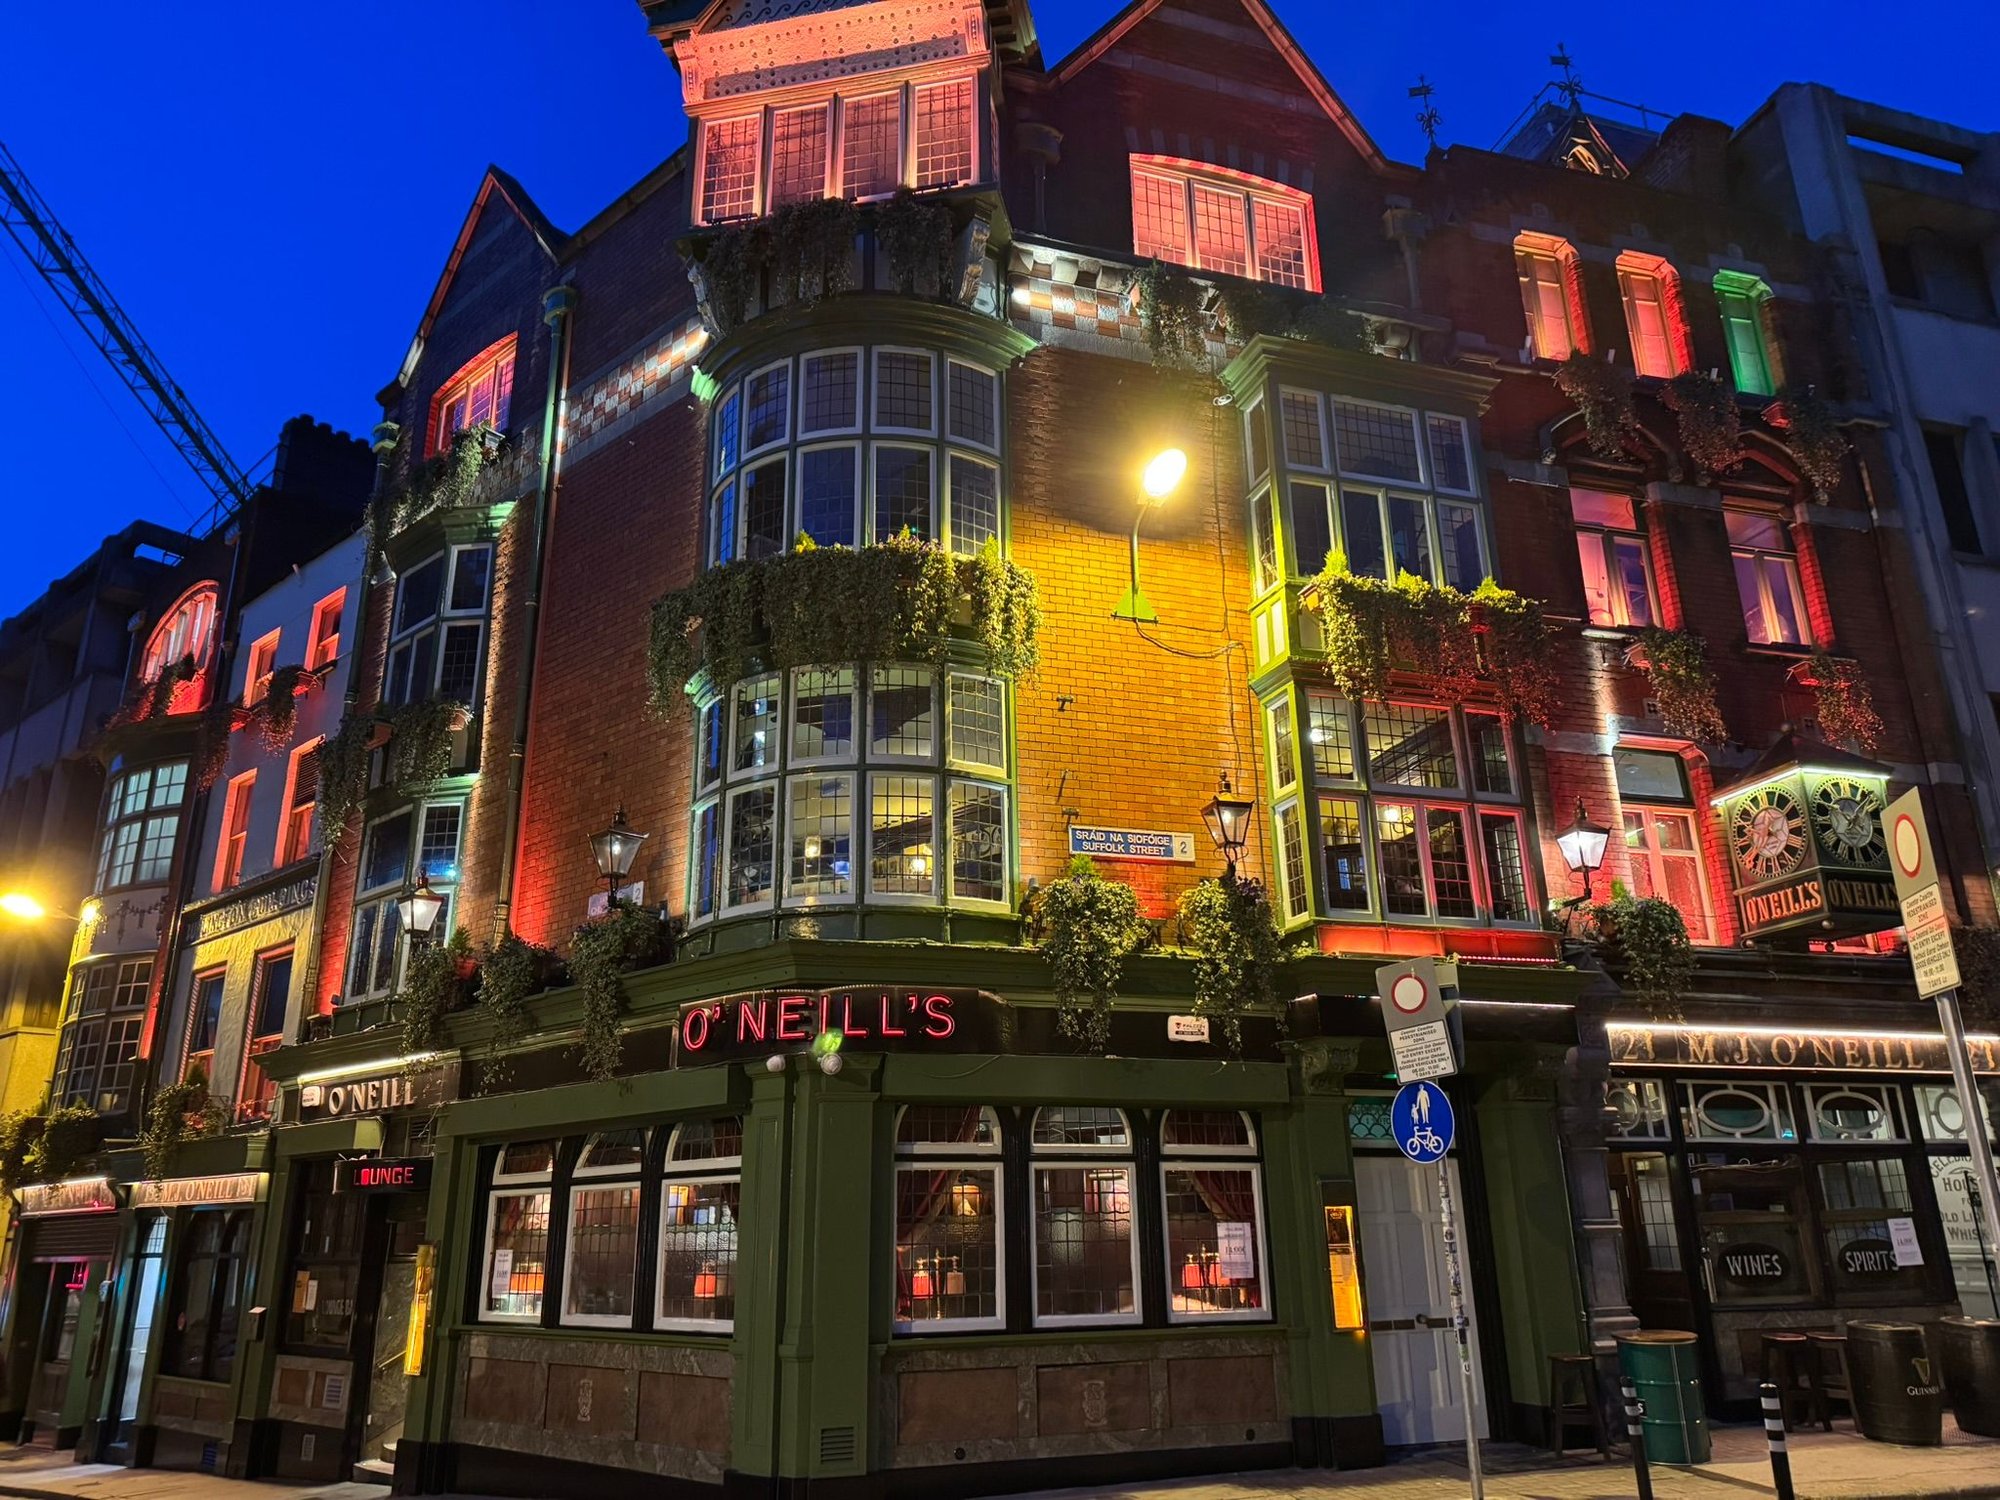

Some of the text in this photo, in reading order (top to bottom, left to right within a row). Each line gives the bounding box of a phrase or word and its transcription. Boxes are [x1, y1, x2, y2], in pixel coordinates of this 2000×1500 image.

[1075, 829, 1105, 841] SRÁID
[1110, 833, 1124, 843] NA
[1082, 841, 1166, 856] SUFFOLK STREET
[1180, 841, 1188, 854] 2
[1746, 881, 1822, 926] O'NEILL'S
[683, 993, 955, 1051] O'NEILL'S
[1620, 1031, 1655, 1060] 21
[1771, 1036, 1924, 1068] O'NEILL
[329, 1077, 414, 1115] O'NEILL
[354, 1167, 414, 1186] LOUNGE
[185, 1178, 233, 1200] O'NEILL
[1726, 1254, 1782, 1277] WINES
[1845, 1251, 1899, 1273] SPIRITS
